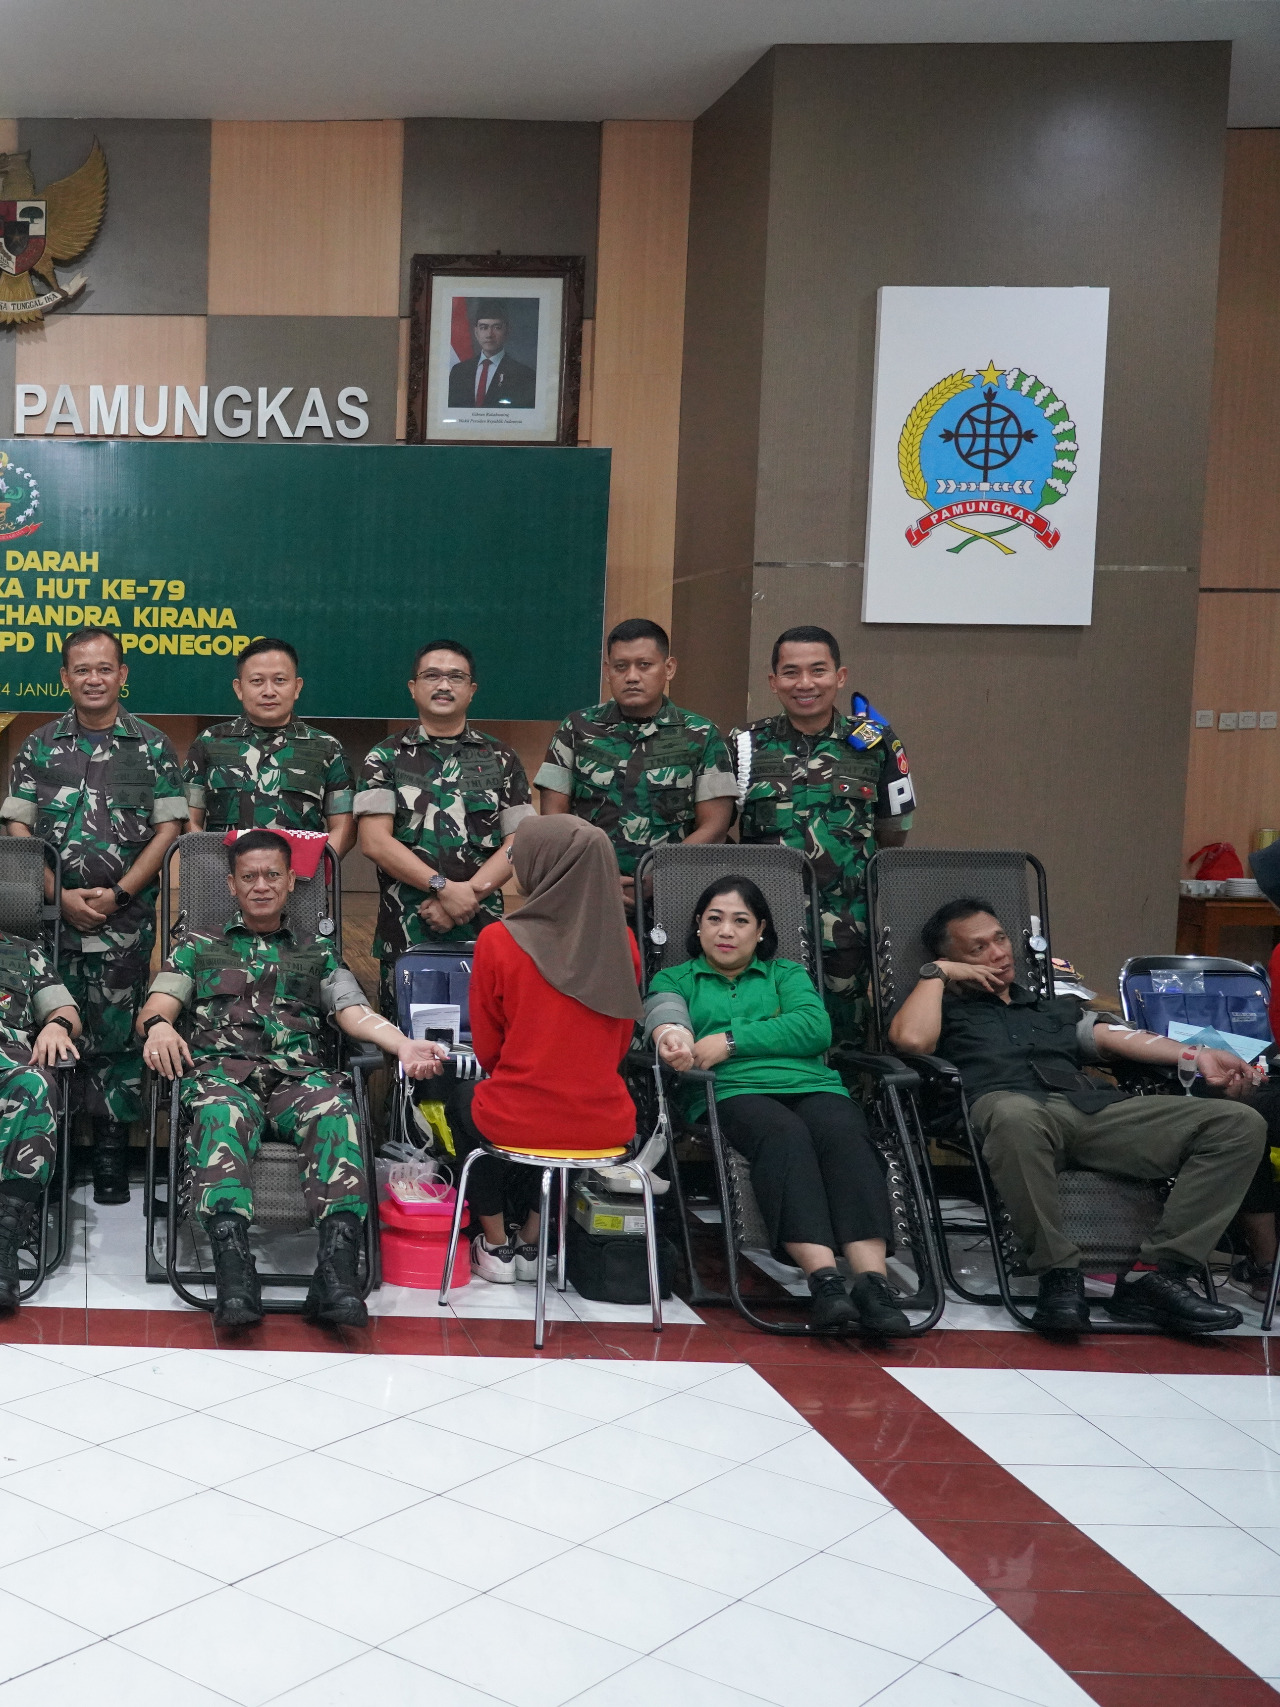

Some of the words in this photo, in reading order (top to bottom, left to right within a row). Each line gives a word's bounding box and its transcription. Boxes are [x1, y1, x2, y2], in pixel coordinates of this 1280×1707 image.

[10, 299, 44, 311] TUNGGAL
[44, 293, 59, 304] IKA
[15, 384, 370, 439] PAMUNGKAS
[930, 501, 1035, 524] PAMUNGKAS
[6, 550, 99, 573] DARAH
[36, 578, 91, 600] HUT
[102, 579, 186, 601] KE-79
[133, 606, 237, 629] KIRANA
[115, 633, 267, 656] PONEGOR
[16, 682, 72, 697] JANUA
